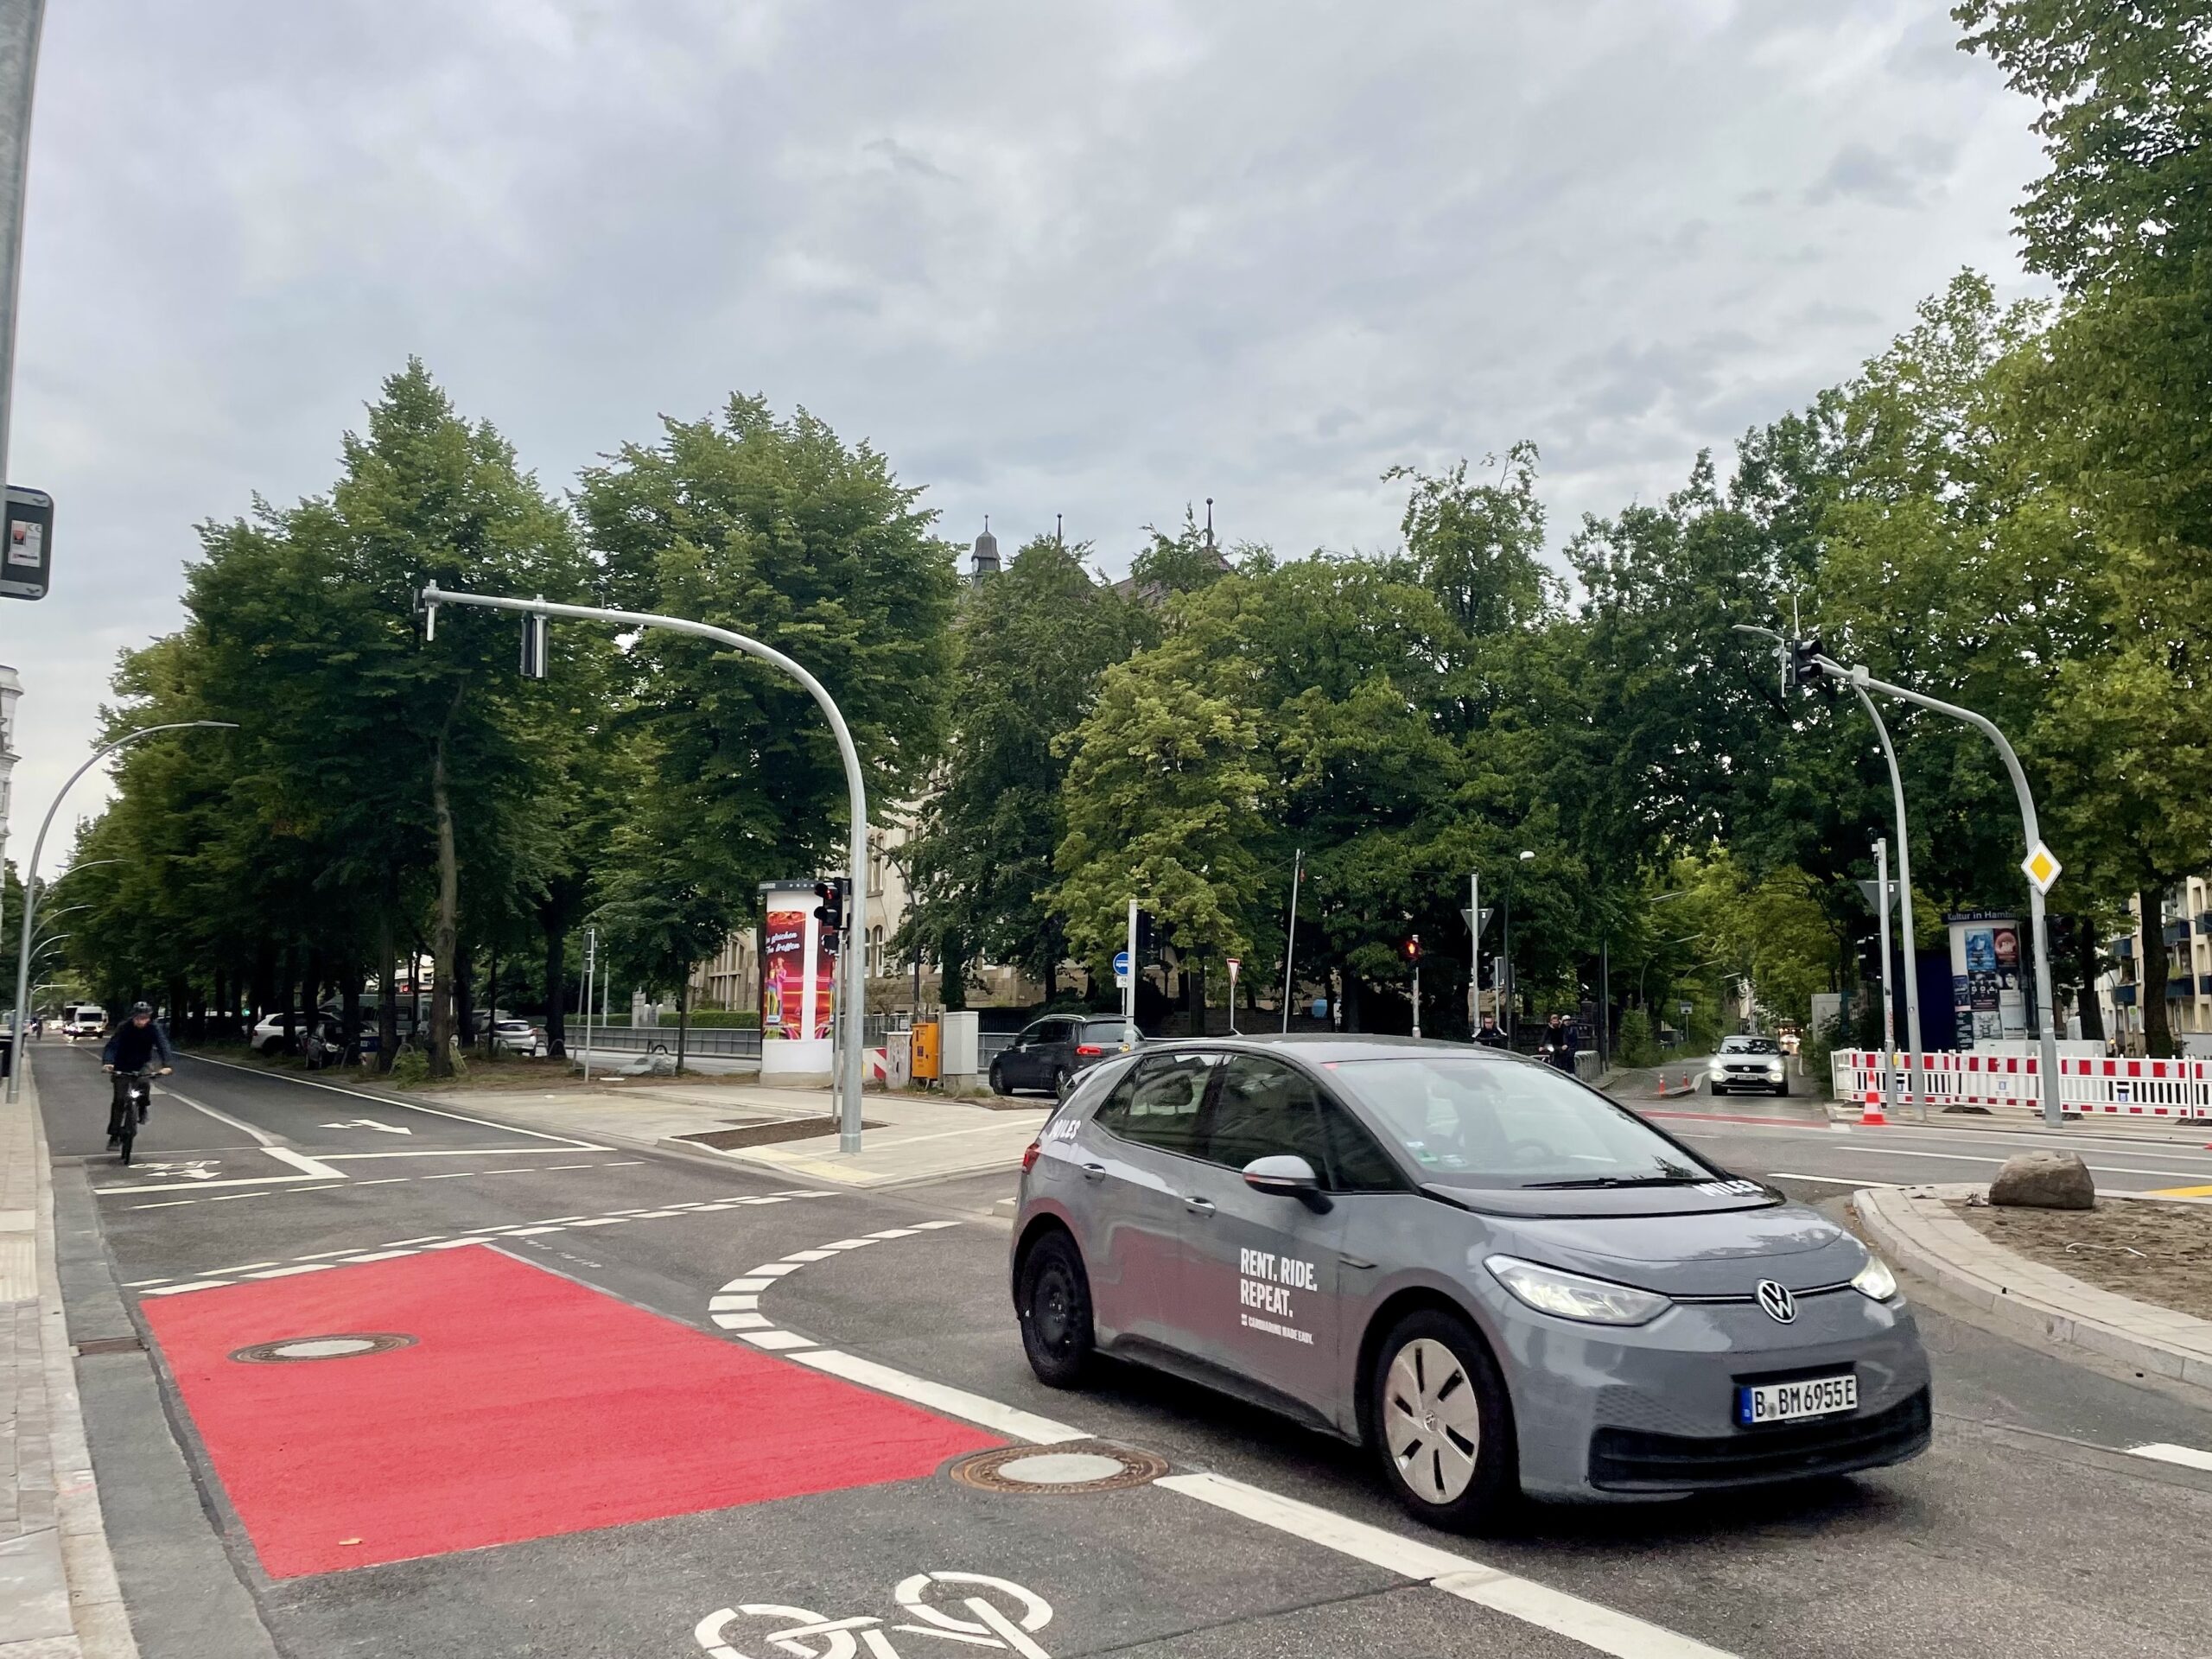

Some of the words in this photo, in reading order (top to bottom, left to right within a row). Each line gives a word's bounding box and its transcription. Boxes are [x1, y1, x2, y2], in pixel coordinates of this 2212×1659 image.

[1948, 912, 1970, 921] Kultur
[1985, 911, 2018, 919] Hambu
[1048, 1119, 1081, 1140] MILES
[1692, 1179, 1764, 1197] MILES
[1241, 1248, 1278, 1282] RENT.
[1281, 1256, 1318, 1292] RIDE.
[1241, 1278, 1294, 1318] REPEAT.
[1755, 1391, 1765, 1417] B
